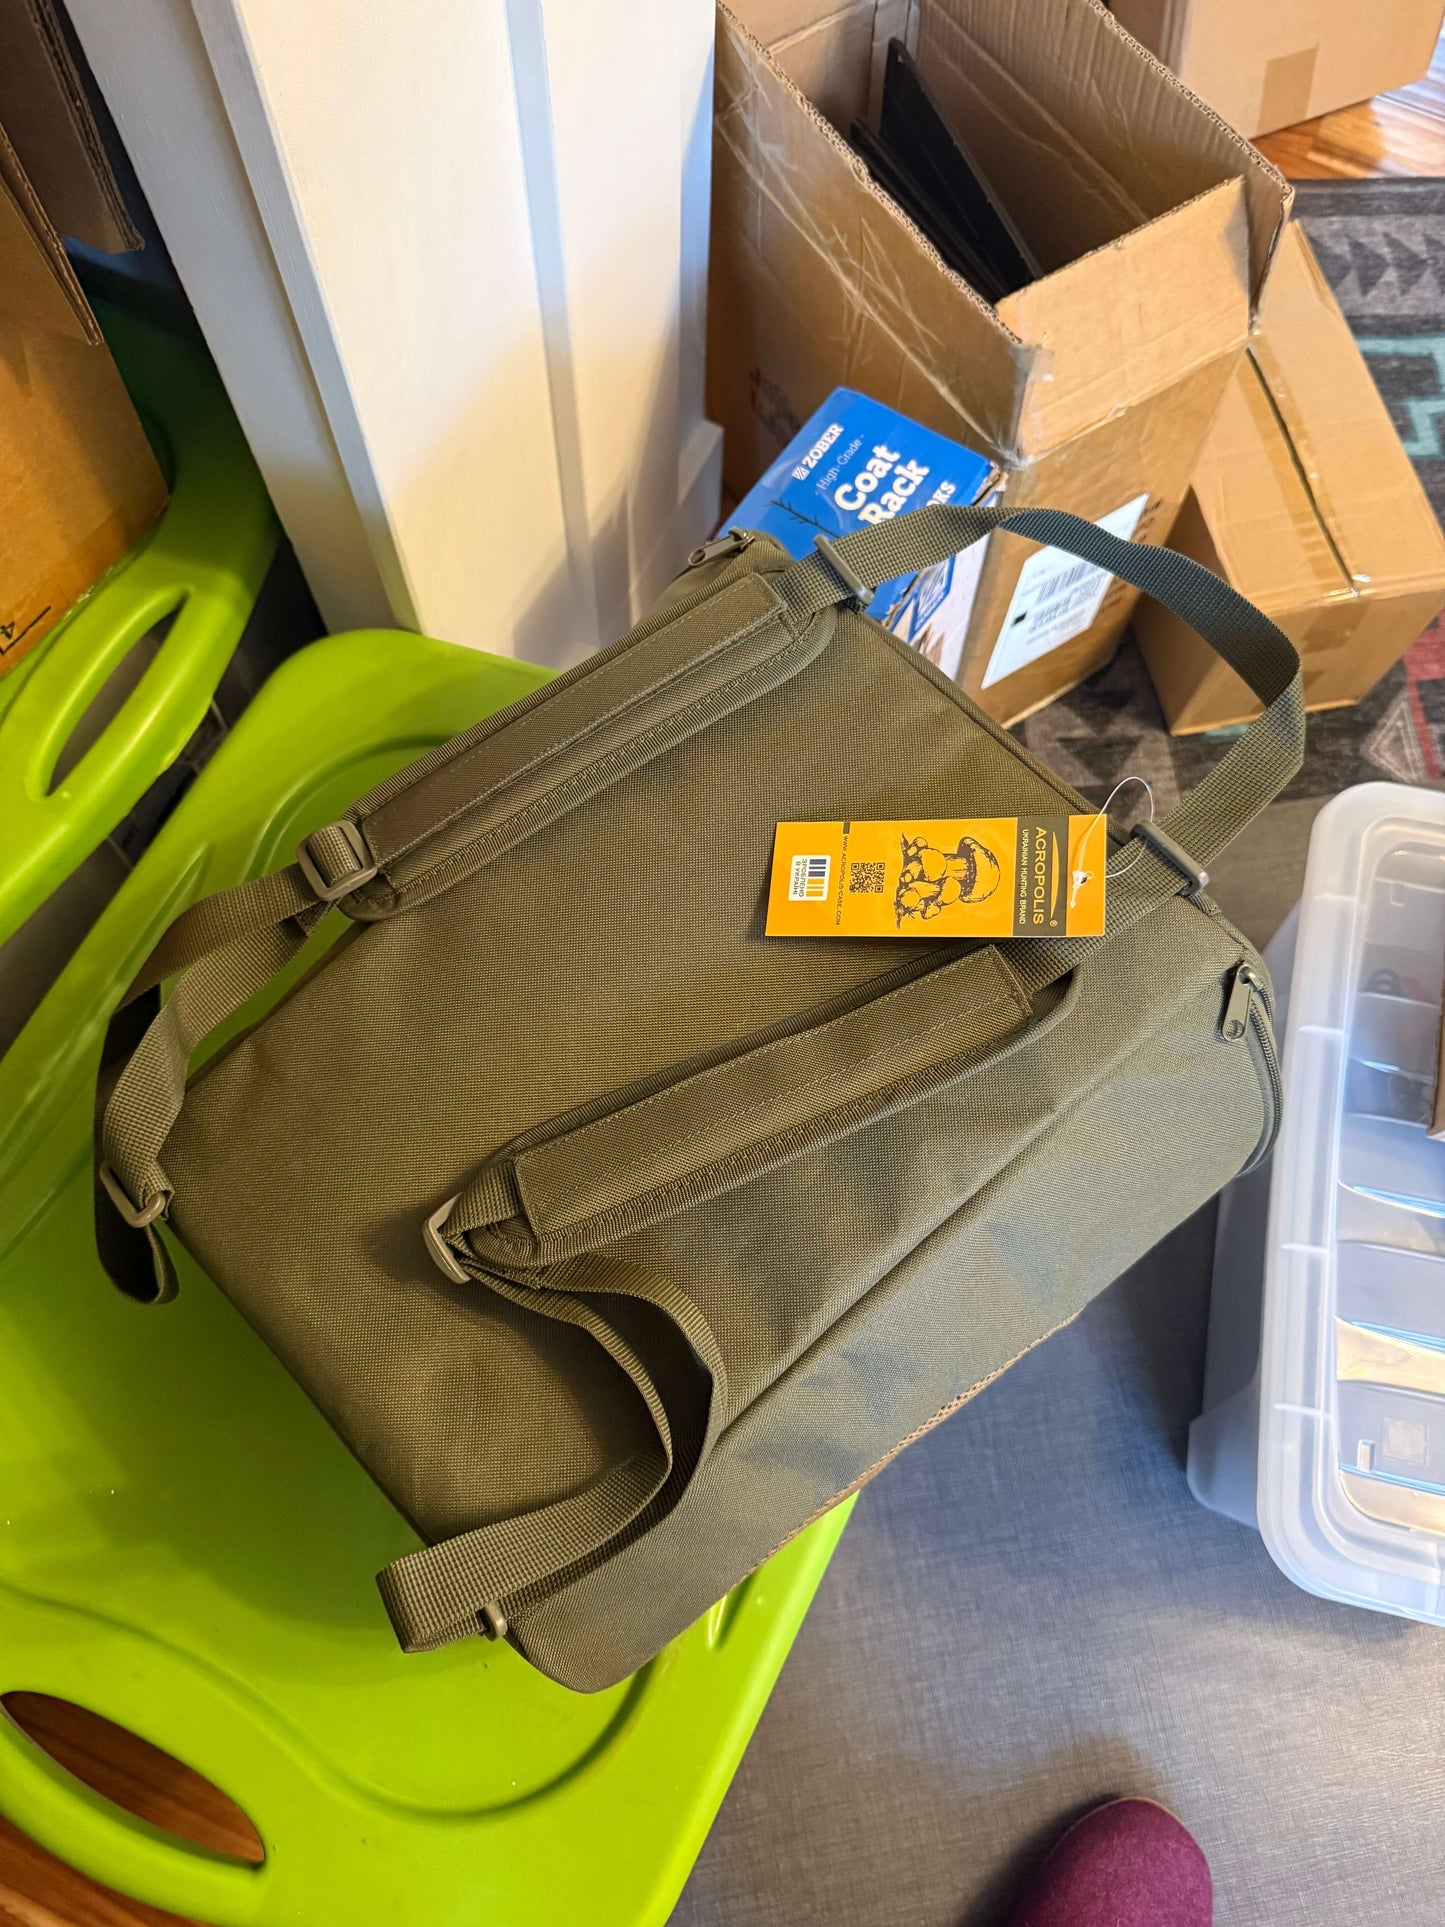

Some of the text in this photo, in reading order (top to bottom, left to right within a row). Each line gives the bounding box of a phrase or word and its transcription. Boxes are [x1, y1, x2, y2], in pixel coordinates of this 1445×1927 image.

[801, 423, 844, 469] ZOBER
[834, 445, 900, 511] Coat
[858, 459, 930, 525] Rack
[792, 868, 801, 895] УКРАЇНІ
[798, 858, 808, 897] ЗРОБЛЕНО
[1019, 829, 1029, 925] UKRAINIAN HUNTING BRAND
[1033, 826, 1047, 925] ACROPOLIS
